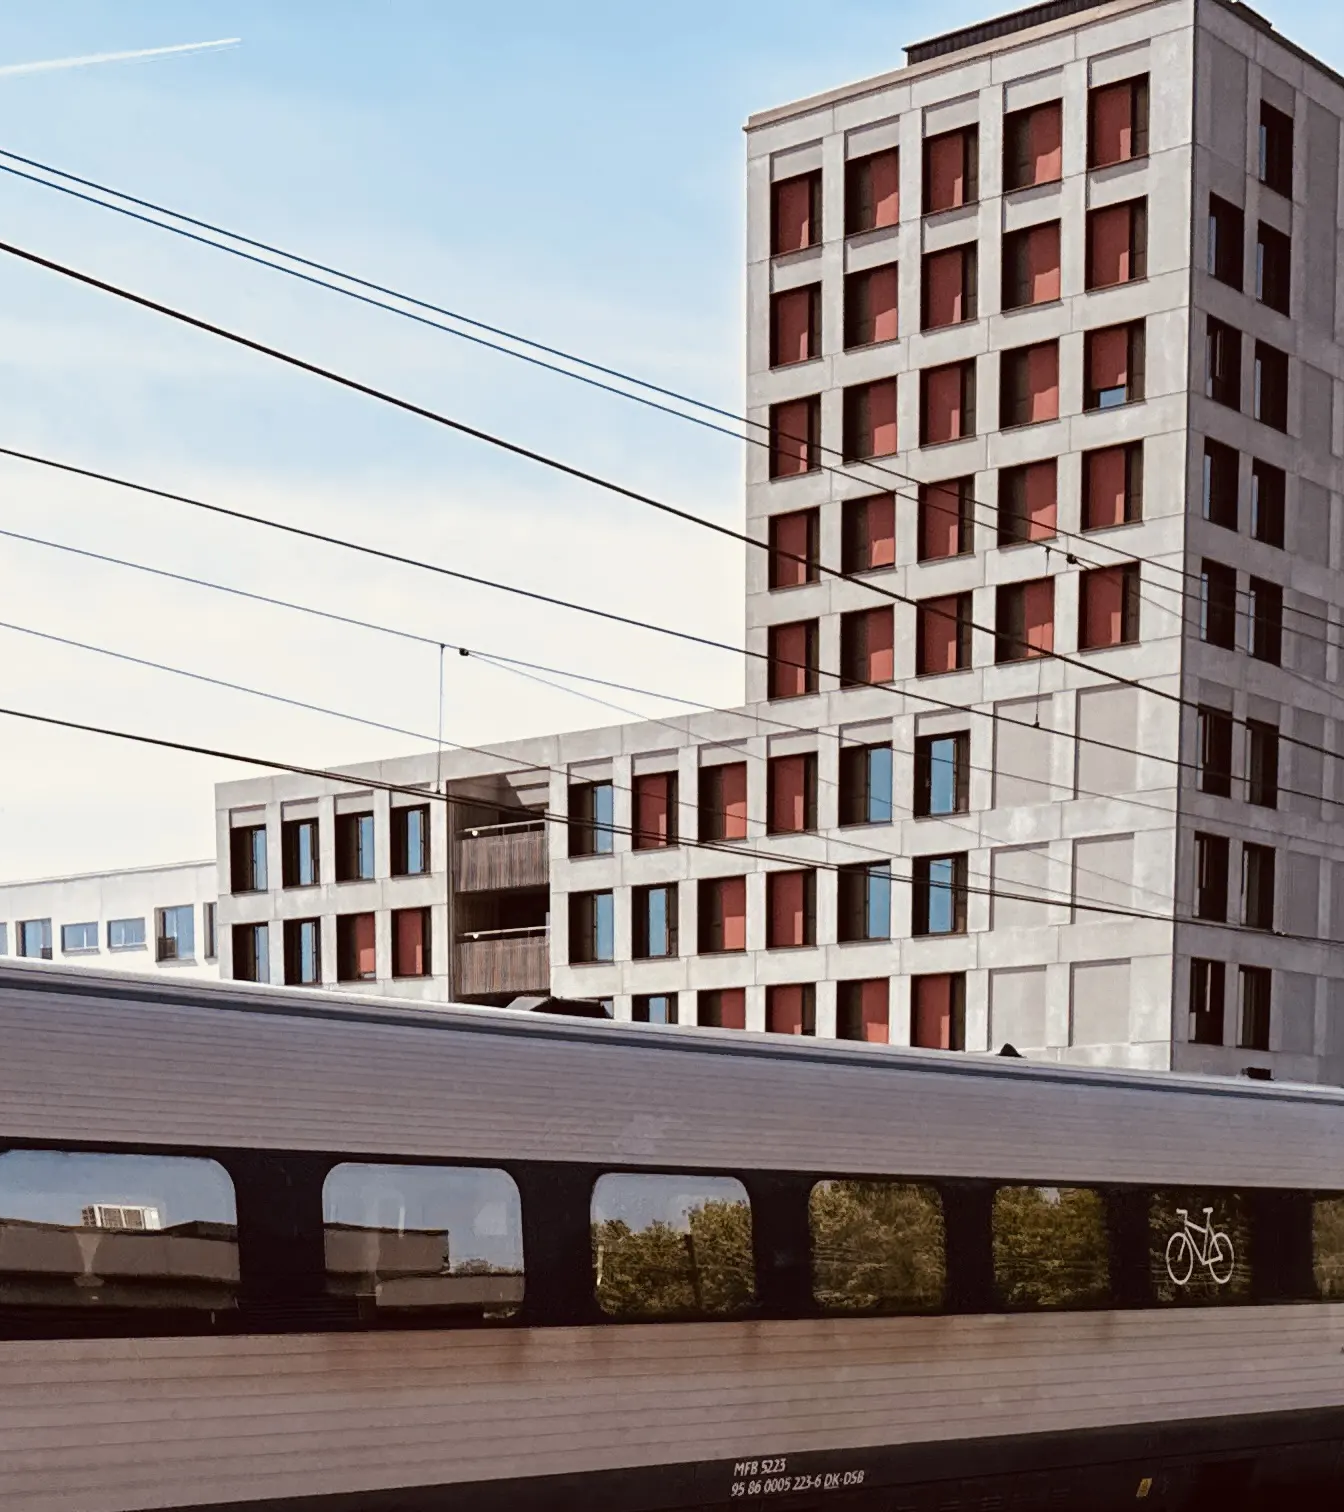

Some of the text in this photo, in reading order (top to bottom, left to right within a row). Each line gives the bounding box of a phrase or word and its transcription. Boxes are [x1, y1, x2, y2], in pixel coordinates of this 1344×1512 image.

[733, 1458, 787, 1477] MFB 5223
[730, 1481, 746, 1497] 95
[747, 1480, 762, 1495] 86
[763, 1477, 792, 1494] 0005
[792, 1474, 823, 1491] 223-6
